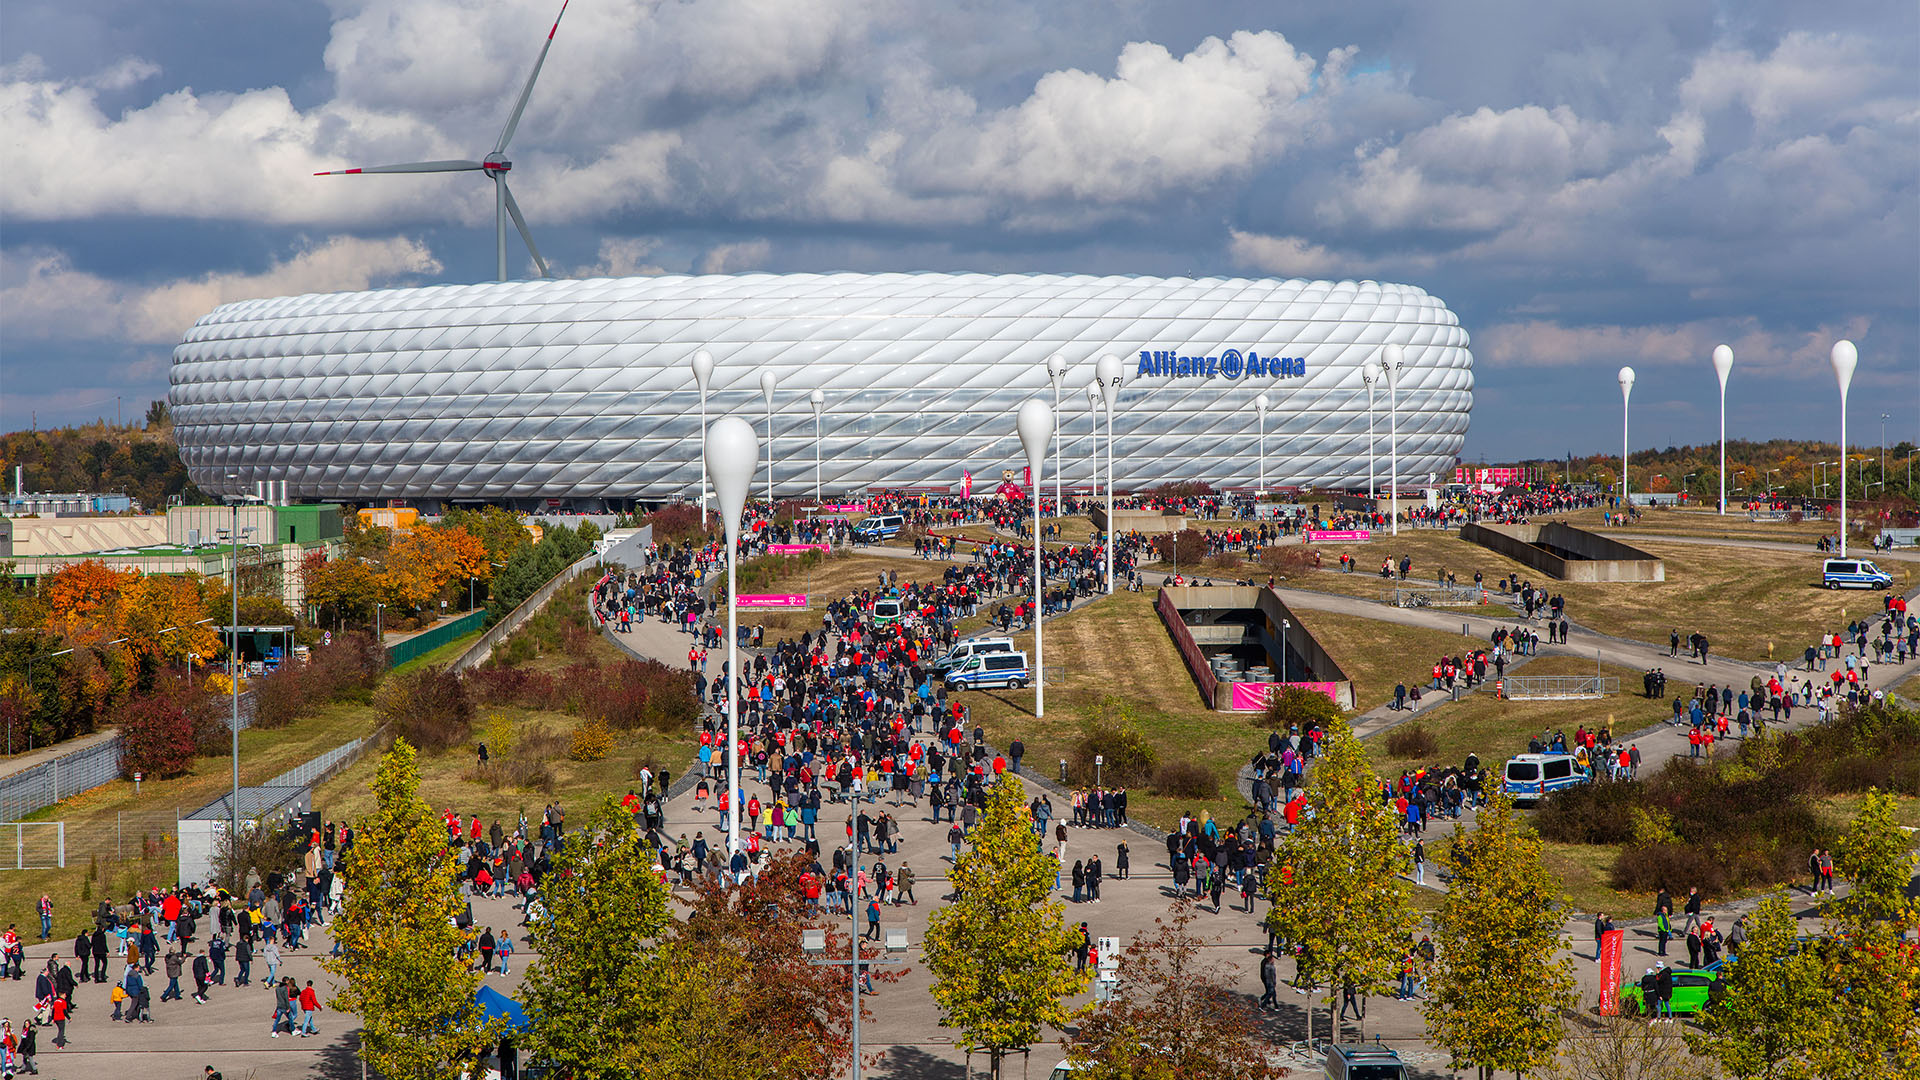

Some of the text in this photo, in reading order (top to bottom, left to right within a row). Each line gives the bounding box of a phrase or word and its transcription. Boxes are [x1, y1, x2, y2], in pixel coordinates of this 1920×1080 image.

[1138, 351, 1306, 376] Allianz Arena
[1609, 936, 1617, 980] experience
